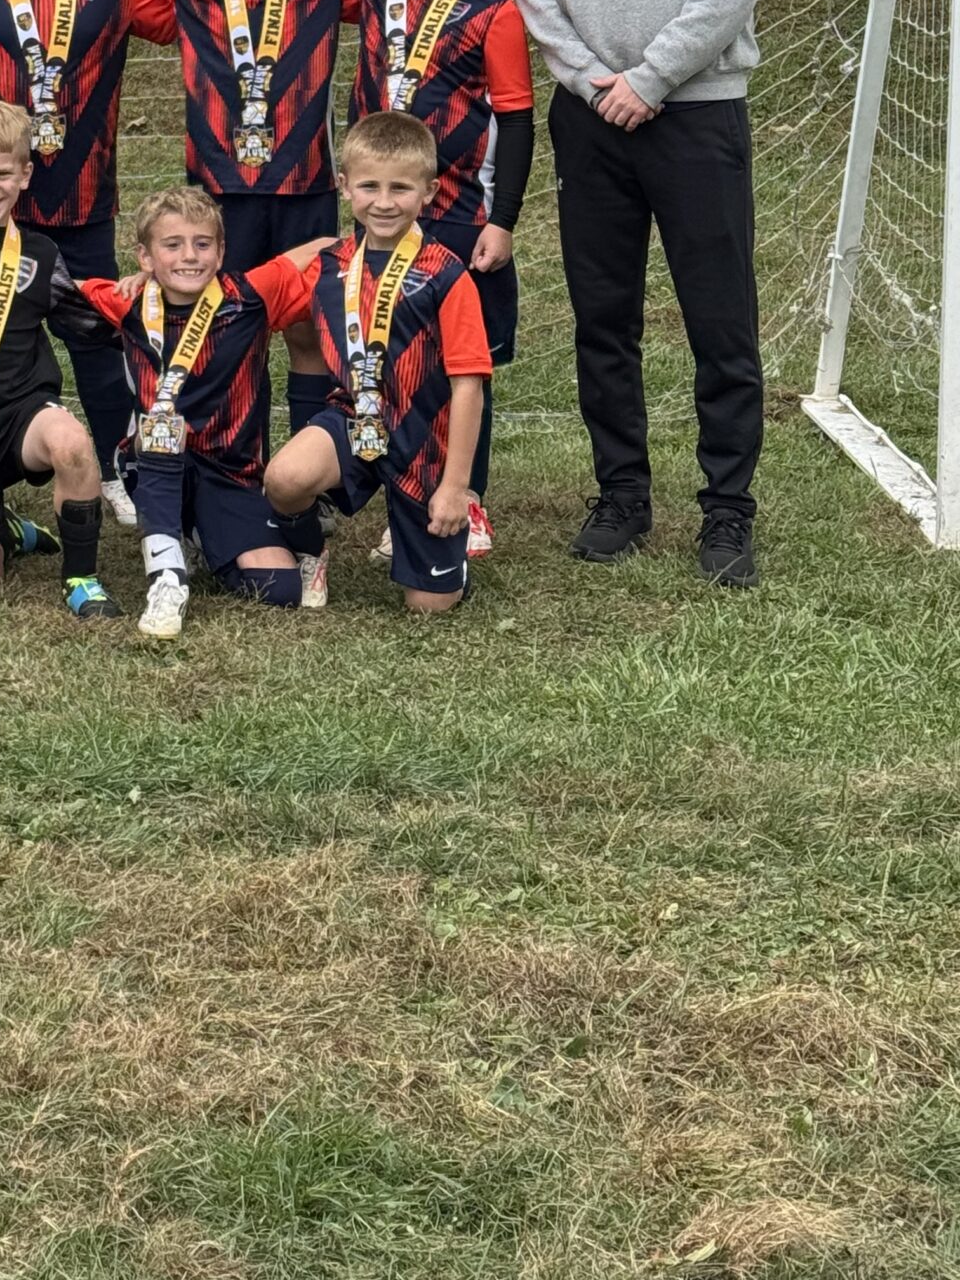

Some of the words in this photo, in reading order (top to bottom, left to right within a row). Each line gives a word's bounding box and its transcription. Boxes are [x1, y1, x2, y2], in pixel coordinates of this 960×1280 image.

[236, 147, 272, 163] WLUSC
[373, 253, 409, 331] FINALIST
[179, 296, 214, 360] FINALIST
[142, 436, 180, 455] WLUSC
[351, 438, 388, 456] WLUSC
